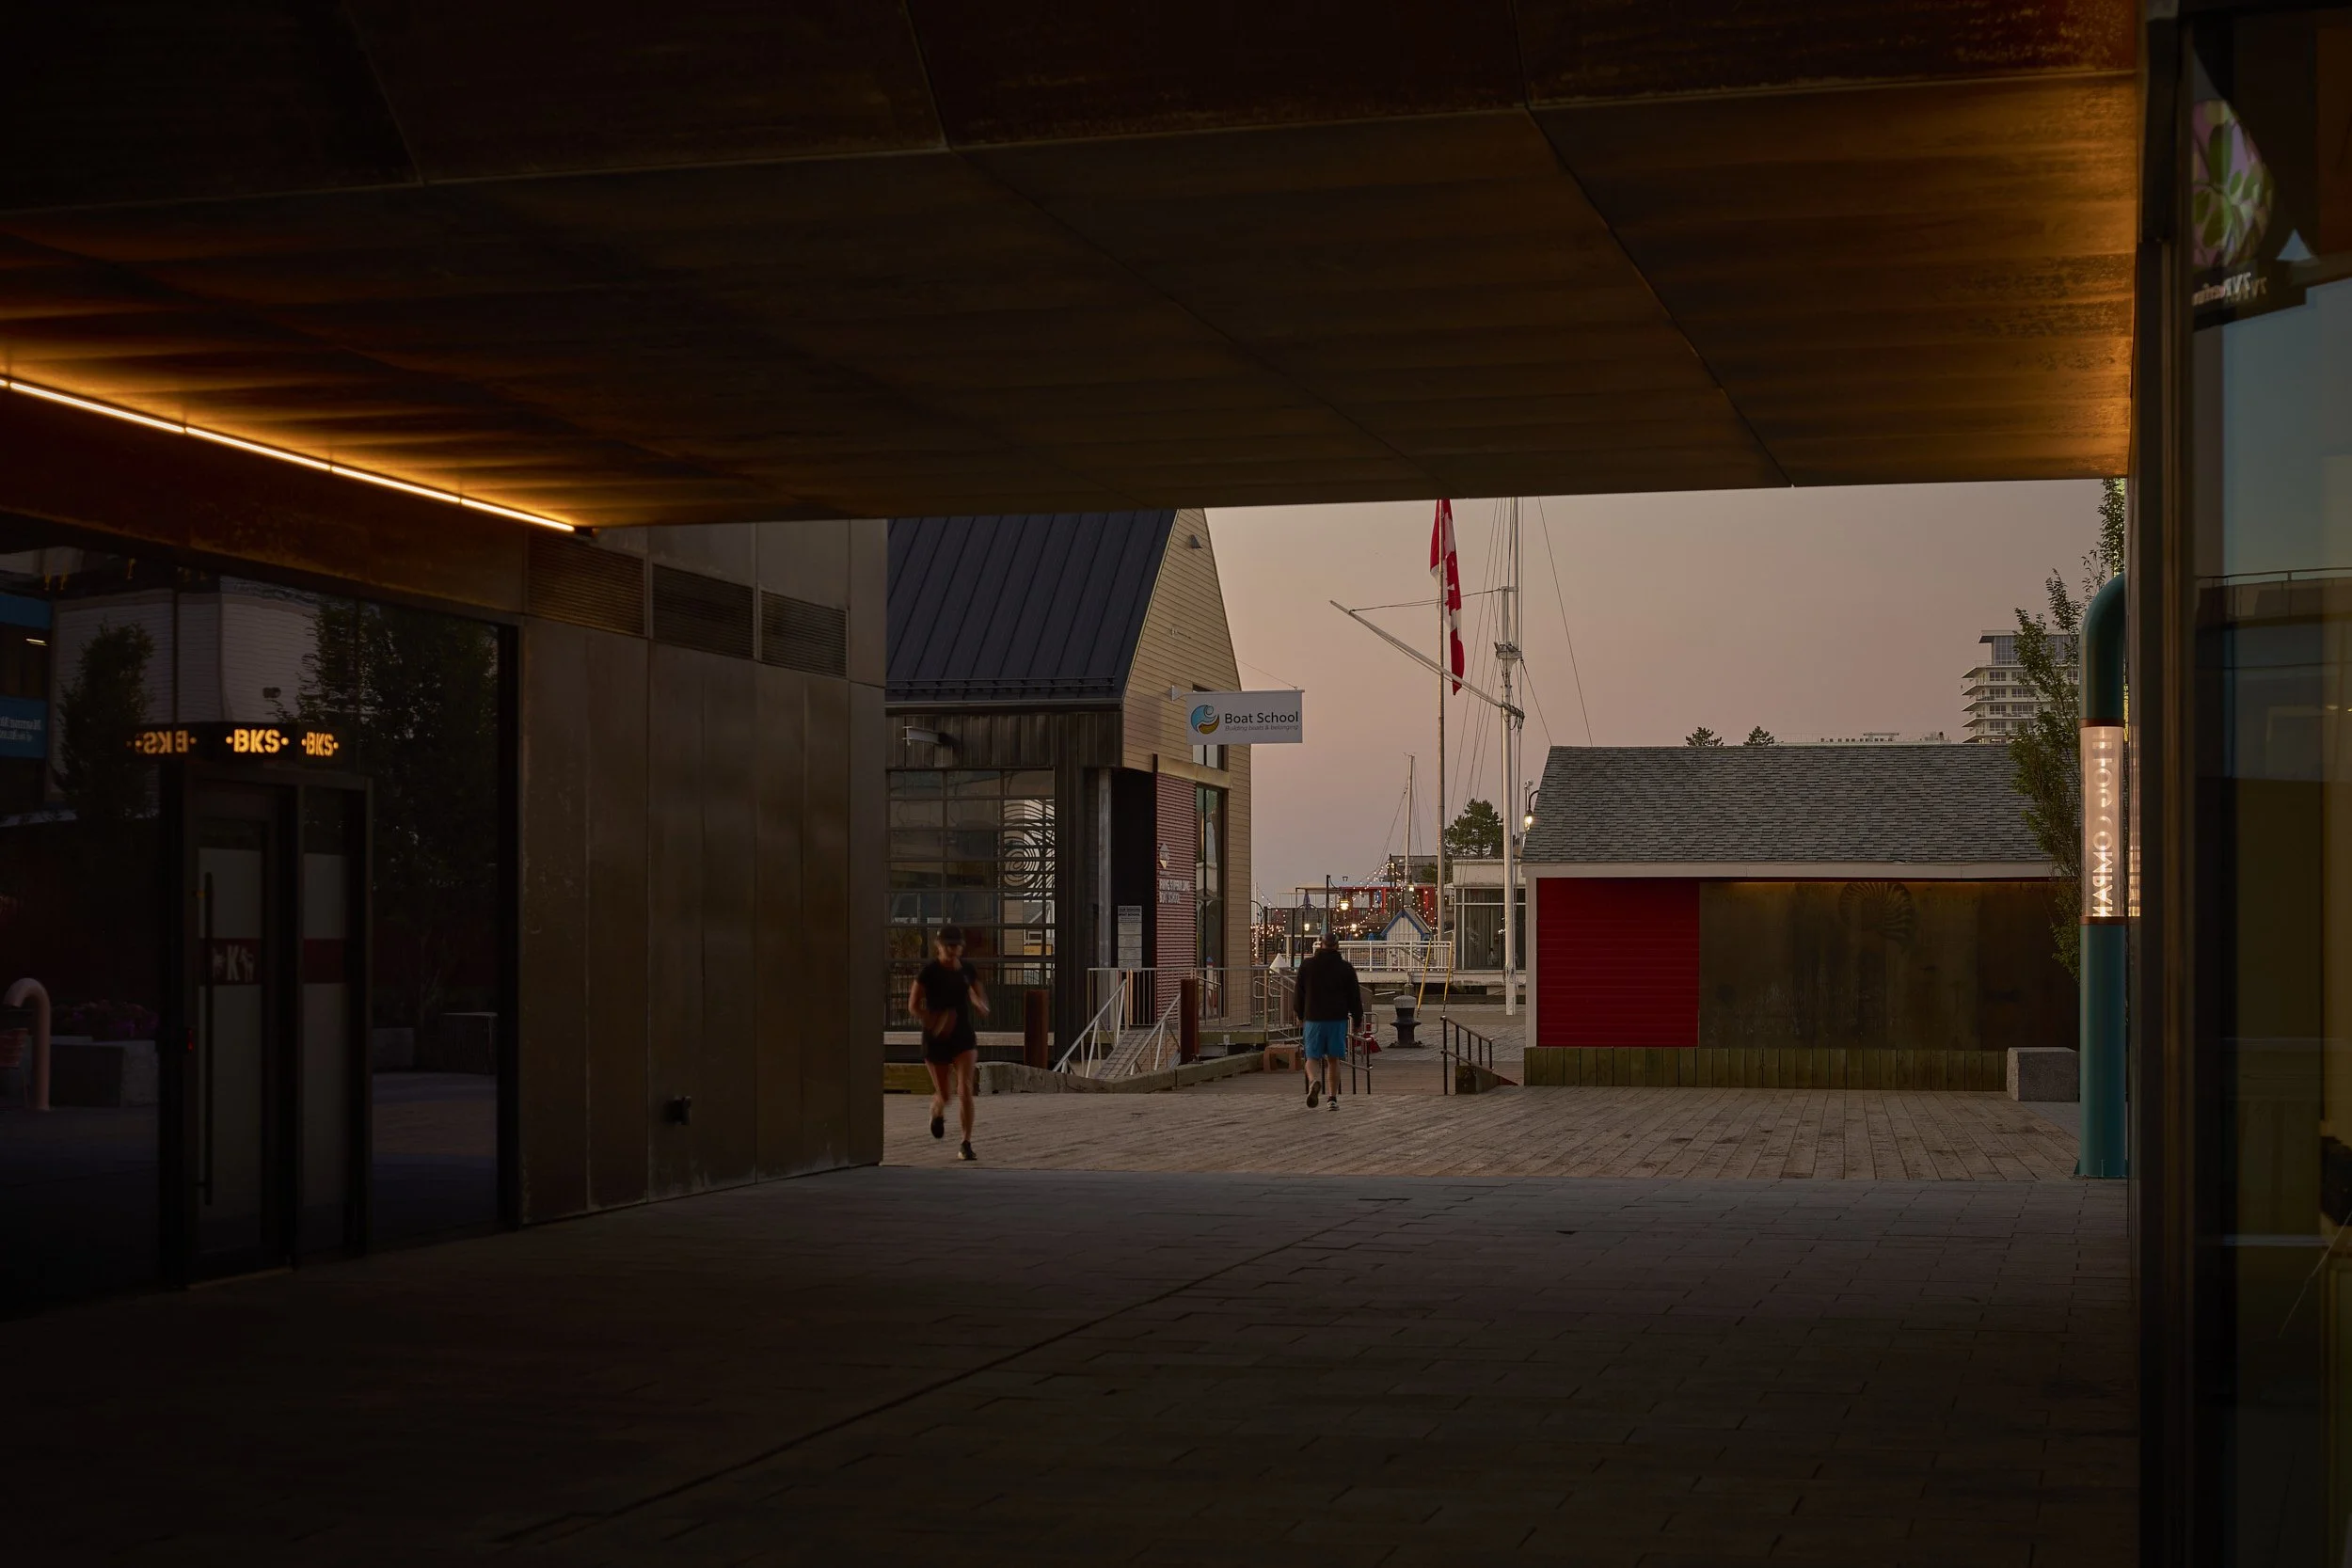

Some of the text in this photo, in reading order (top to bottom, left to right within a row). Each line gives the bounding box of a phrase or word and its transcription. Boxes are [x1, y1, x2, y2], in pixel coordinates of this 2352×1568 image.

[1225, 711, 1298, 723] Boat School
[233, 728, 281, 753] BKS
[307, 732, 334, 756] BKS
